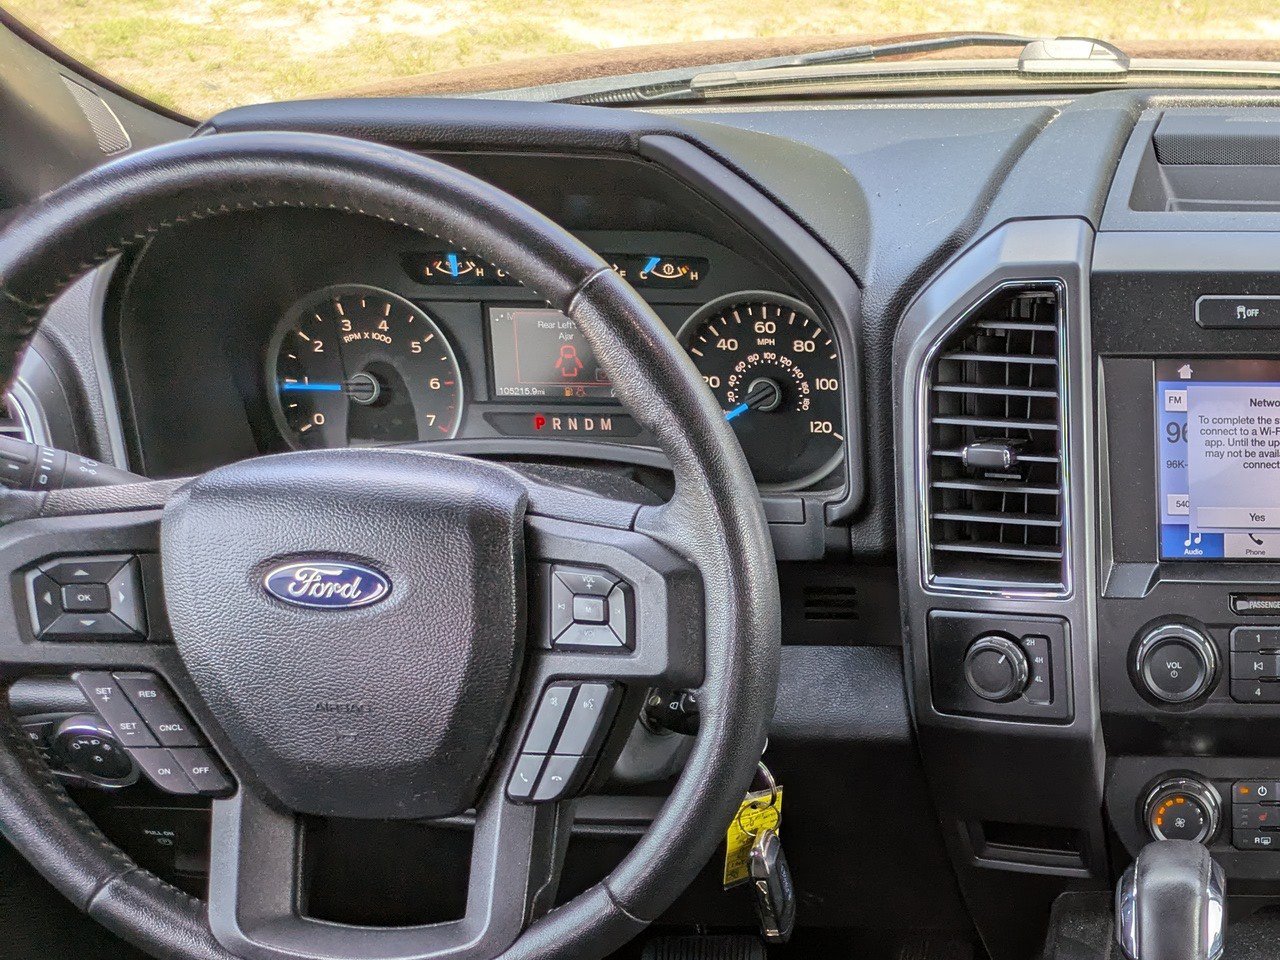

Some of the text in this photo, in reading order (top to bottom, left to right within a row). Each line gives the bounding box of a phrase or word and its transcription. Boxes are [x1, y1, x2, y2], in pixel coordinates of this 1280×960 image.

[476, 268, 484, 276] H
[691, 272, 698, 280] H
[1247, 308, 1259, 318] OFF
[342, 320, 352, 332] 3
[379, 320, 389, 332] 4
[538, 320, 572, 328] Rear Left
[755, 322, 776, 333] 60
[344, 332, 361, 343] RPM
[372, 332, 392, 344] 1000
[757, 338, 775, 346] MPH
[314, 341, 323, 352] 2
[411, 342, 421, 353] 5
[717, 339, 738, 350] 40
[793, 340, 815, 352] 80
[748, 354, 759, 362] 80
[764, 352, 776, 360] 100
[780, 356, 792, 366] 120
[735, 362, 746, 372] 60
[793, 366, 804, 378] 140
[430, 378, 440, 390] 6
[728, 375, 736, 387] 40
[816, 379, 838, 390] 100
[728, 391, 735, 402] 20
[1168, 396, 1181, 404] FM
[314, 414, 324, 425] 0
[427, 415, 435, 426] 7
[535, 418, 612, 430] P R N D M
[1198, 416, 1210, 424] To
[1212, 416, 1255, 426] complete
[1257, 416, 1272, 424] the
[810, 421, 832, 433] 120
[1200, 428, 1237, 436] connect
[1240, 428, 1249, 436] to
[1204, 440, 1225, 449] app.
[1228, 438, 1248, 446] Until
[1251, 438, 1265, 446] the
[1205, 452, 1225, 460] may
[1227, 450, 1242, 458] not
[1245, 450, 1256, 458] be
[1243, 461, 1280, 469] connect
[1250, 513, 1265, 521] Yes
[288, 567, 362, 599] Ford
[77, 594, 92, 602] OK
[96, 687, 112, 695] SET
[138, 690, 156, 698] RES
[1255, 688, 1261, 696] 4
